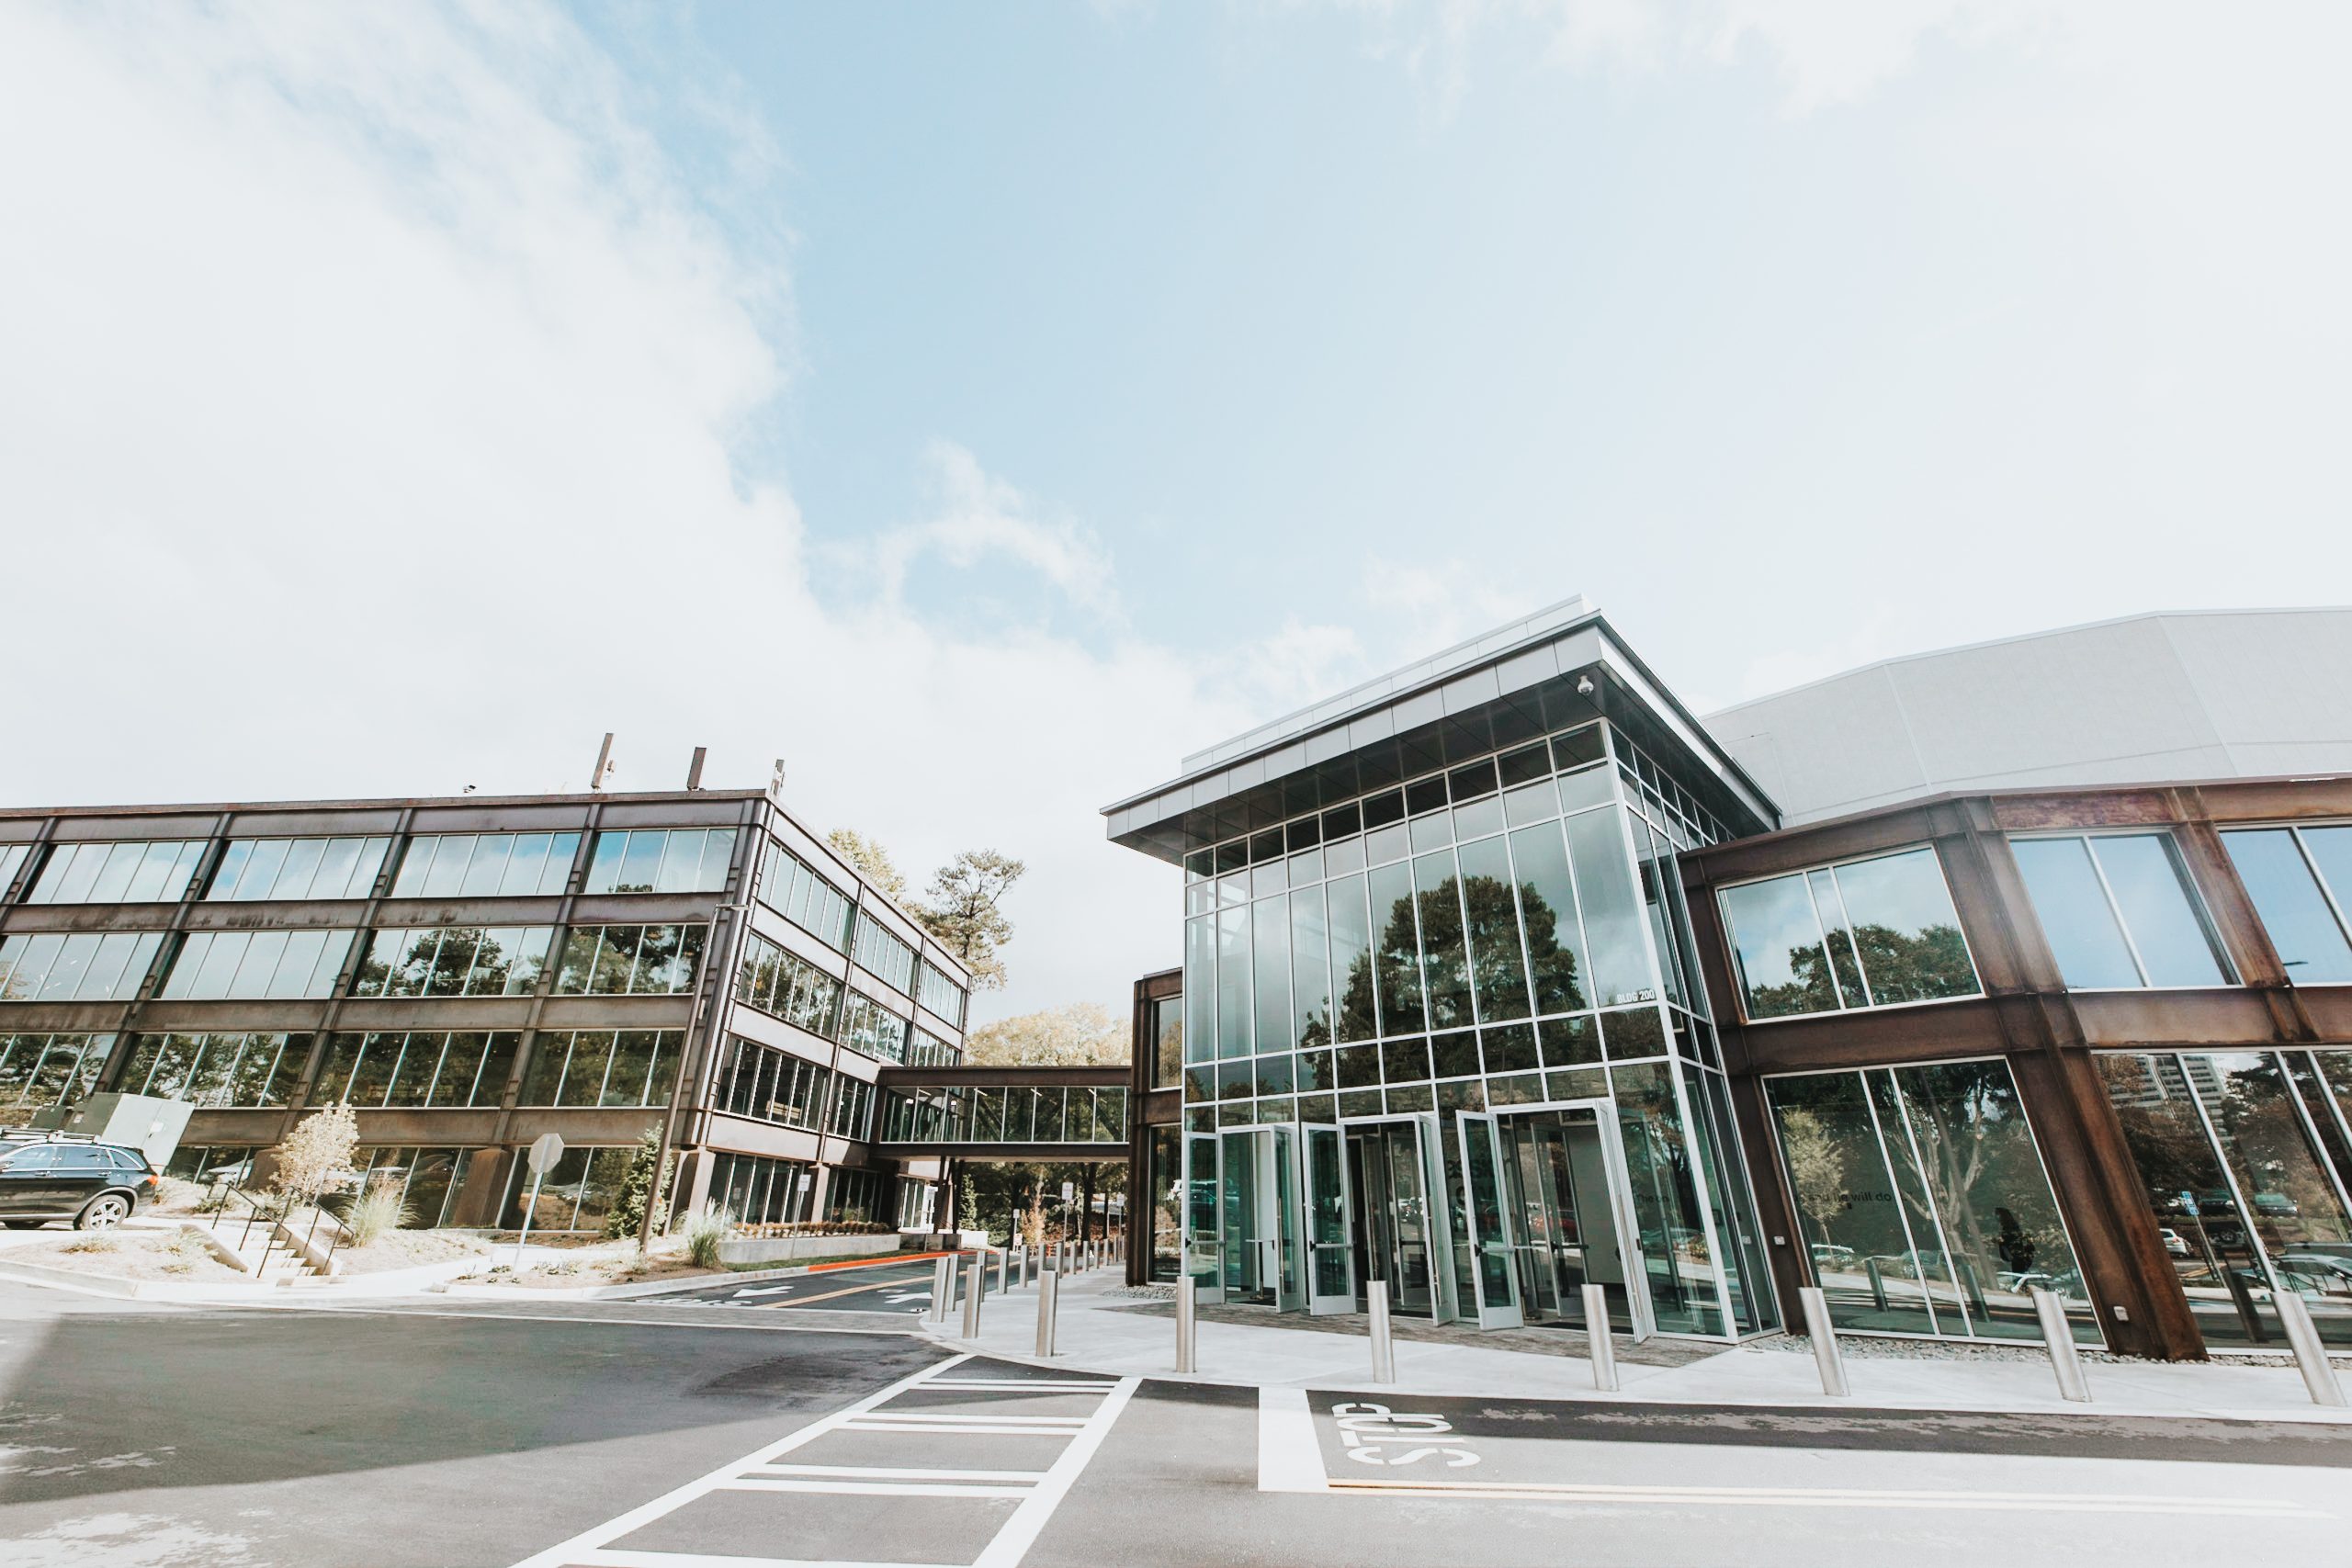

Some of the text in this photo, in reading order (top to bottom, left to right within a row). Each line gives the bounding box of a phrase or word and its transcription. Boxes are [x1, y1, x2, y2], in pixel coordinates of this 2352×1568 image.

[1617, 989, 1655, 1004] BLDG 200
[1851, 1192, 1872, 1202] will
[1875, 1192, 1892, 1202] do
[1332, 1403, 1481, 1467] STOP
